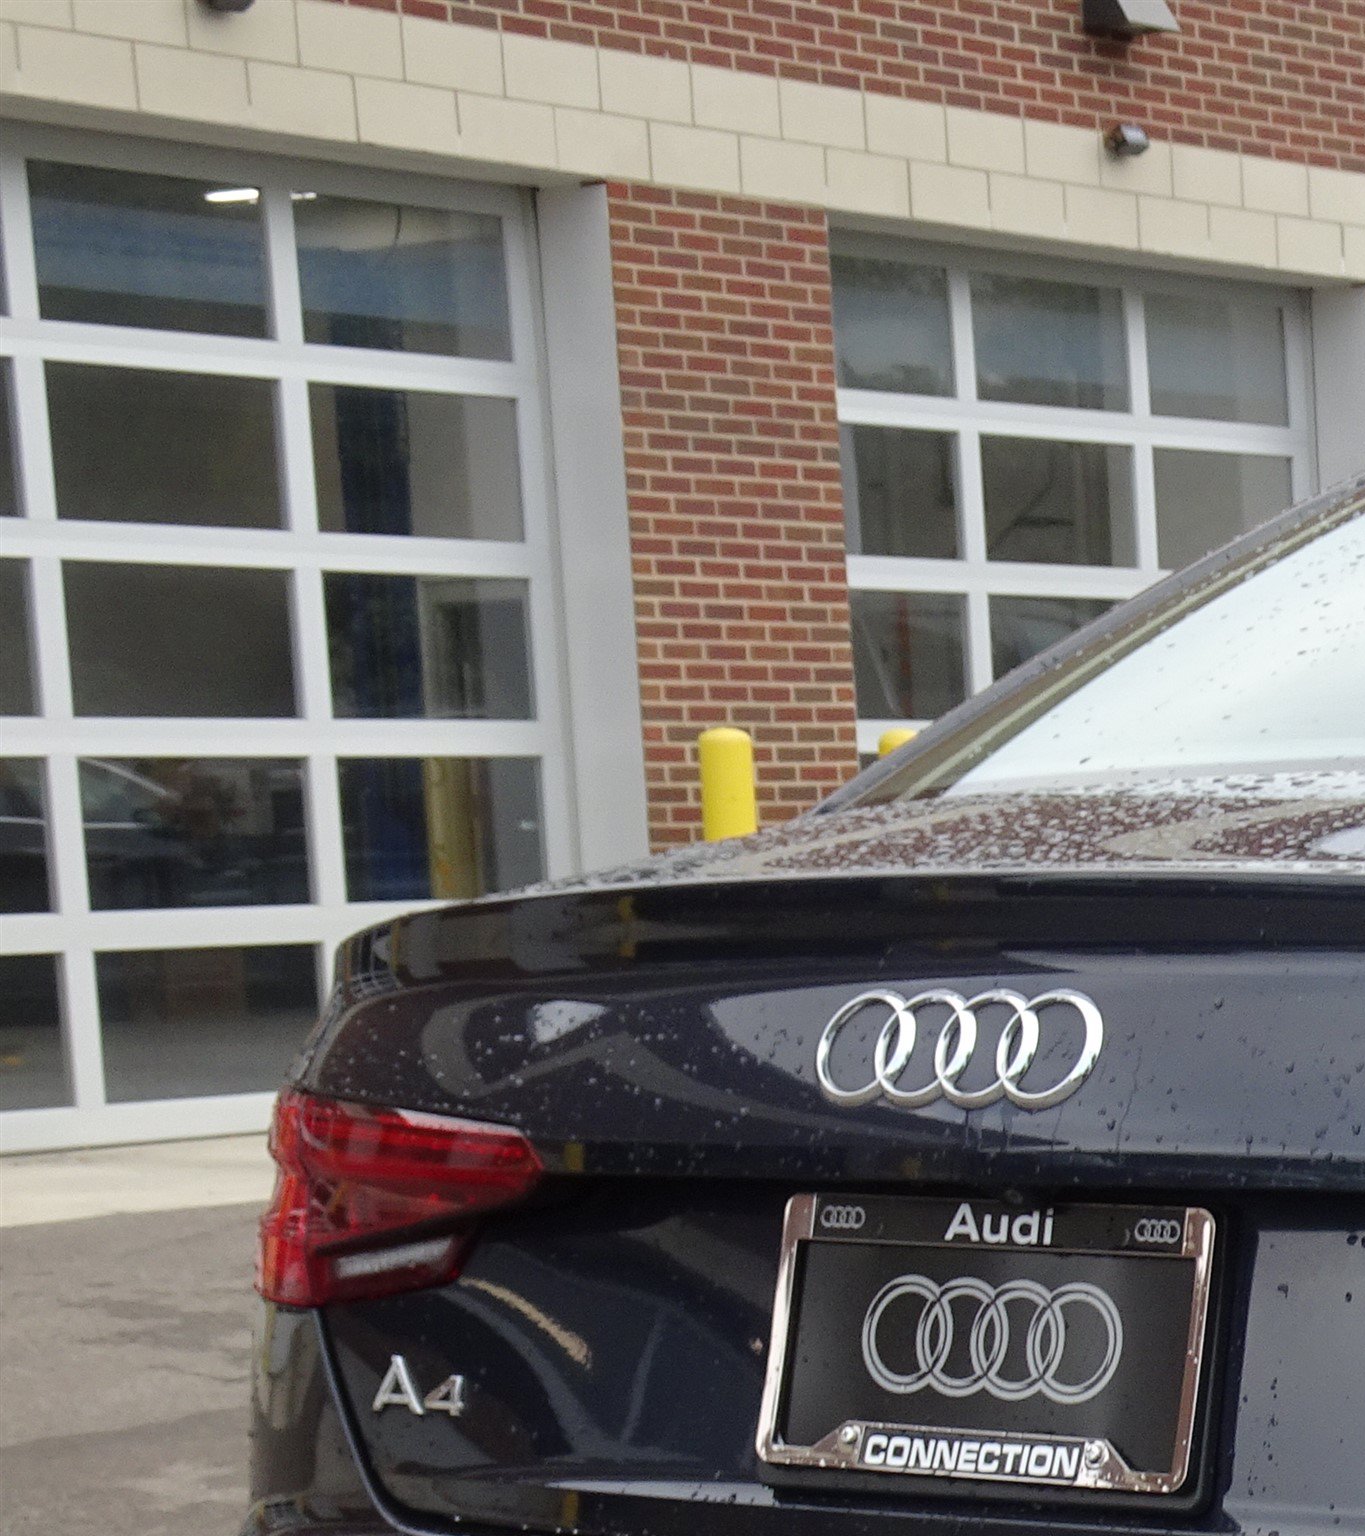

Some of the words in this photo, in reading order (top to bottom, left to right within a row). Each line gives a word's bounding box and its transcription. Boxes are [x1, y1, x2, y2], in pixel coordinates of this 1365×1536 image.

[944, 1202, 1054, 1245] Audi
[372, 1353, 464, 1416] A4
[864, 1434, 1079, 1477] CONNECTION
